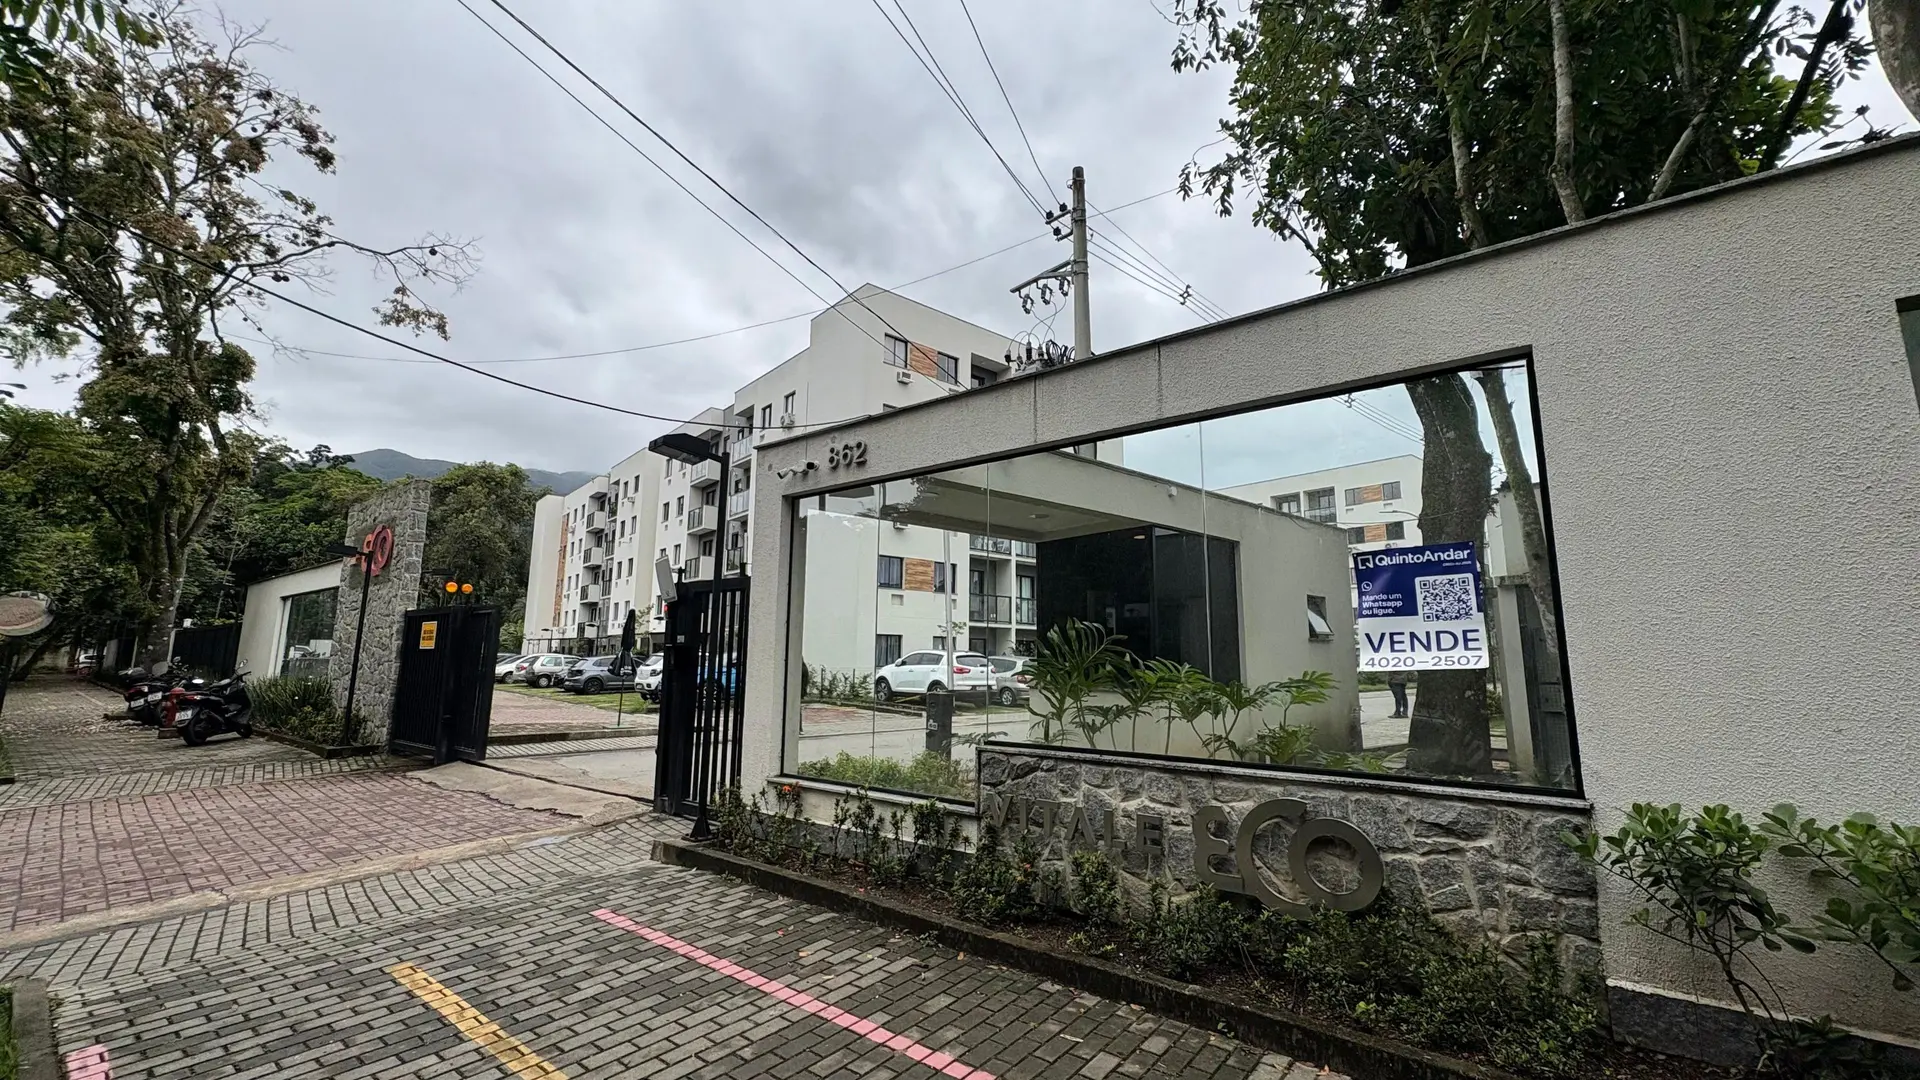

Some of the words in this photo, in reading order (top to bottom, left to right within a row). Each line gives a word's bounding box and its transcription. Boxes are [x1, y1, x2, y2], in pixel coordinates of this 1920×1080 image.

[828, 440, 868, 469] 862
[1375, 548, 1471, 566] QuintoAndar
[1362, 593, 1388, 602] Mande
[1362, 600, 1403, 609] Whatsapp
[1372, 607, 1396, 616] ligue.
[1364, 628, 1483, 653] VENDE
[1364, 655, 1483, 668] 4020-2507
[984, 791, 1165, 855] VITALE
